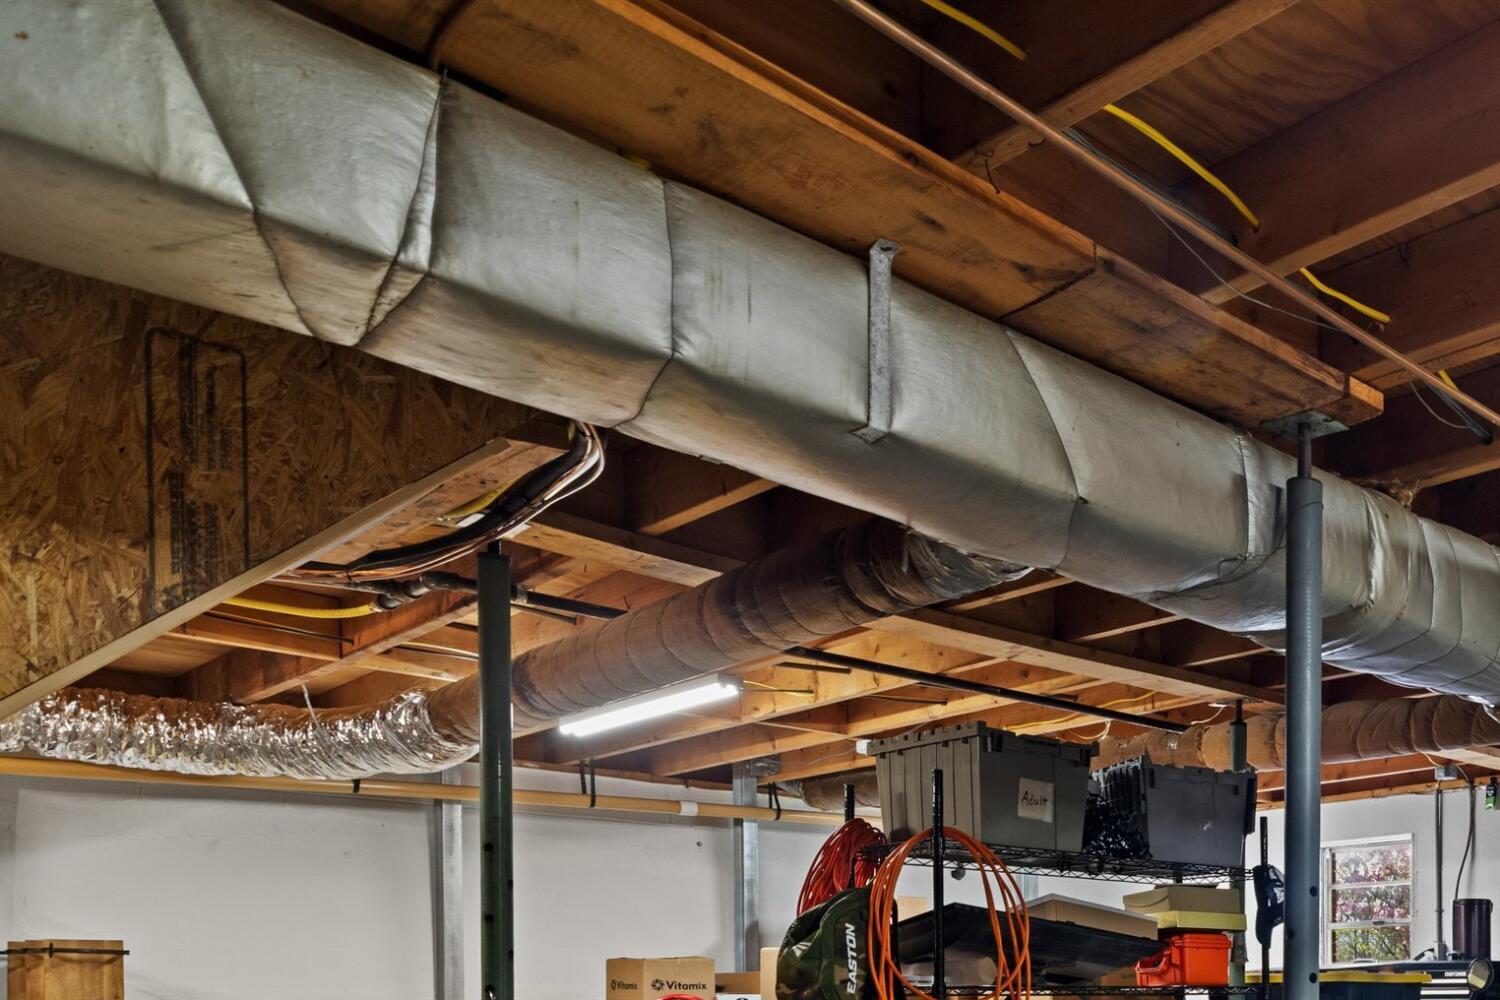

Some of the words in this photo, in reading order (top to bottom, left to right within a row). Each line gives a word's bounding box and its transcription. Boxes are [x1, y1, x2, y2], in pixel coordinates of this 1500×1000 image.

[1020, 790, 1049, 807] Adult
[845, 922, 858, 994] EASTON
[616, 981, 638, 990] Vitamix
[666, 980, 707, 990] Vitamix
